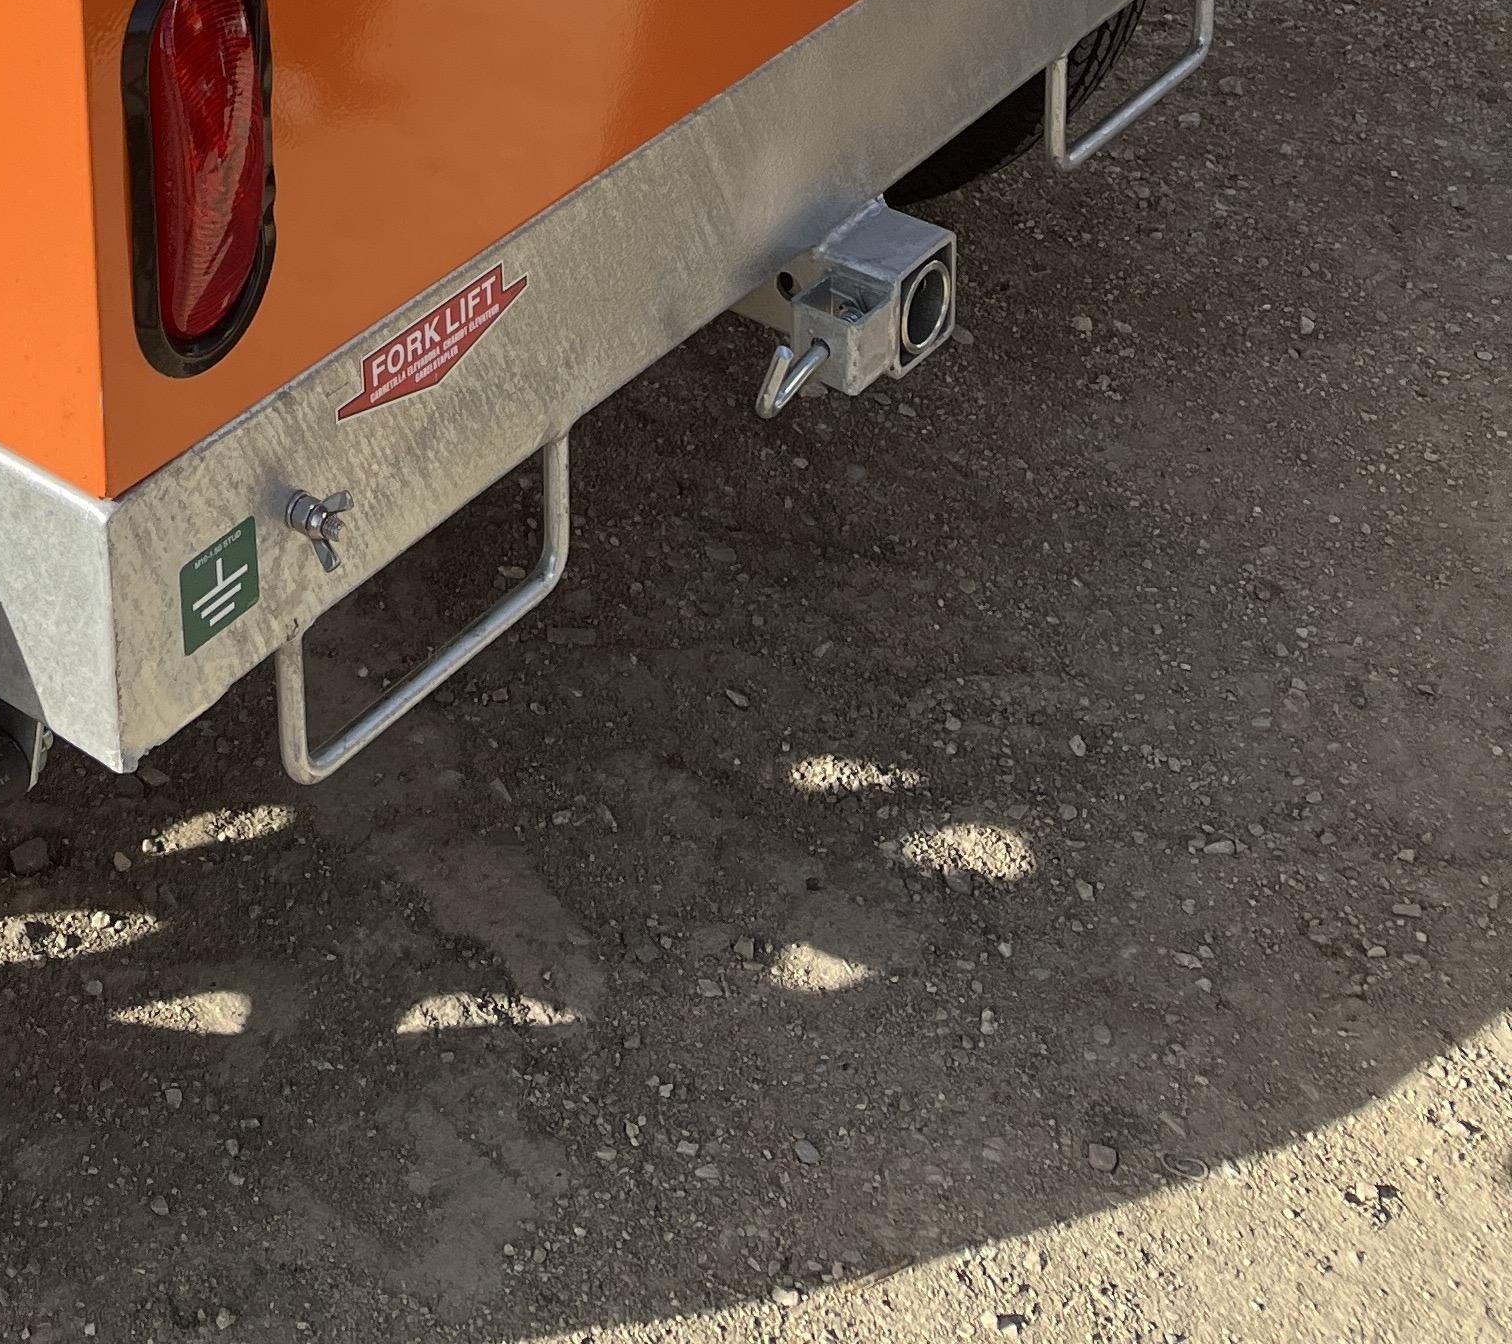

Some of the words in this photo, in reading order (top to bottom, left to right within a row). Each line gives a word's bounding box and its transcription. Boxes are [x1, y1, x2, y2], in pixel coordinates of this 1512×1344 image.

[372, 315, 441, 387] FORK
[445, 275, 497, 335] LIFT
[222, 529, 242, 548] STUD
